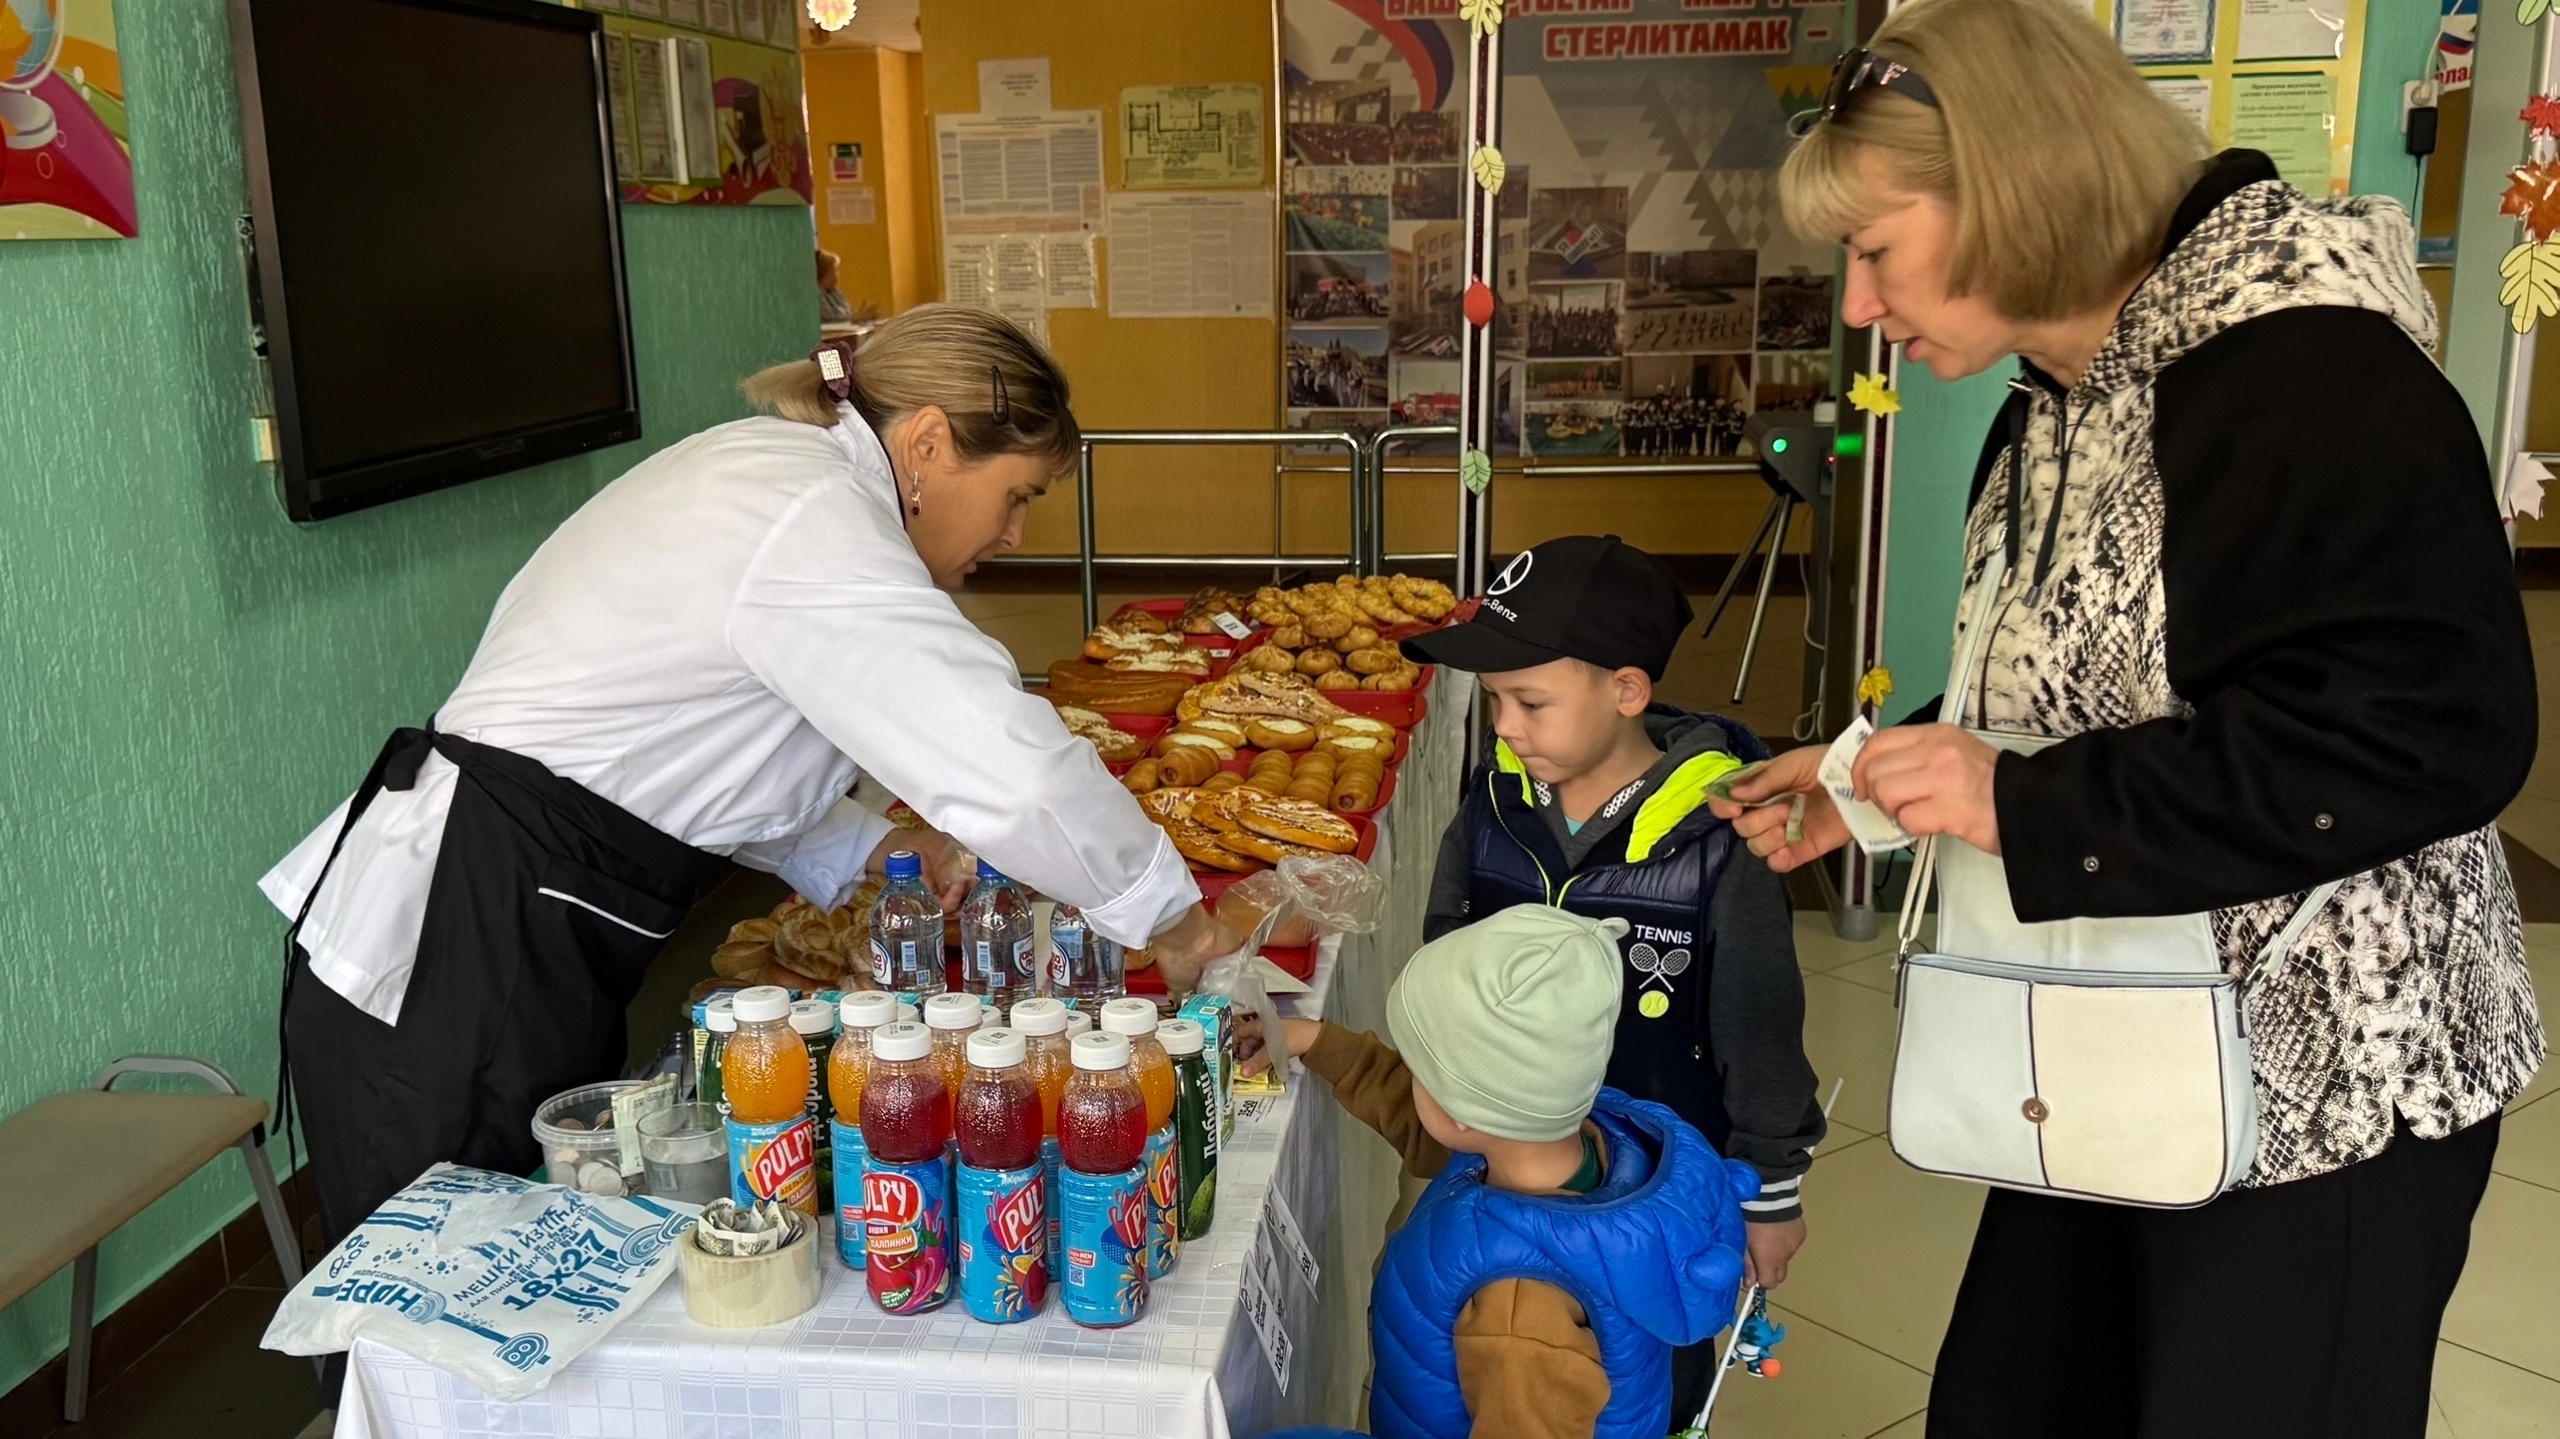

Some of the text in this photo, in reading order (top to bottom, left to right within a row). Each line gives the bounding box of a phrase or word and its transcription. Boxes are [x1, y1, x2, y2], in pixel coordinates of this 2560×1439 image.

[1545, 19, 1788, 58] СТЕРЛИТАМАК
[1481, 598, 1518, 622] -Benz
[1634, 924, 1693, 945] TENNIS
[759, 1124, 813, 1193] PULPY
[541, 1203, 593, 1256] продукто
[1007, 1177, 1044, 1244] PUL
[453, 1248, 522, 1302] МЕШКИ
[518, 1228, 544, 1249] ИЗ
[335, 1278, 422, 1313] HDPE
